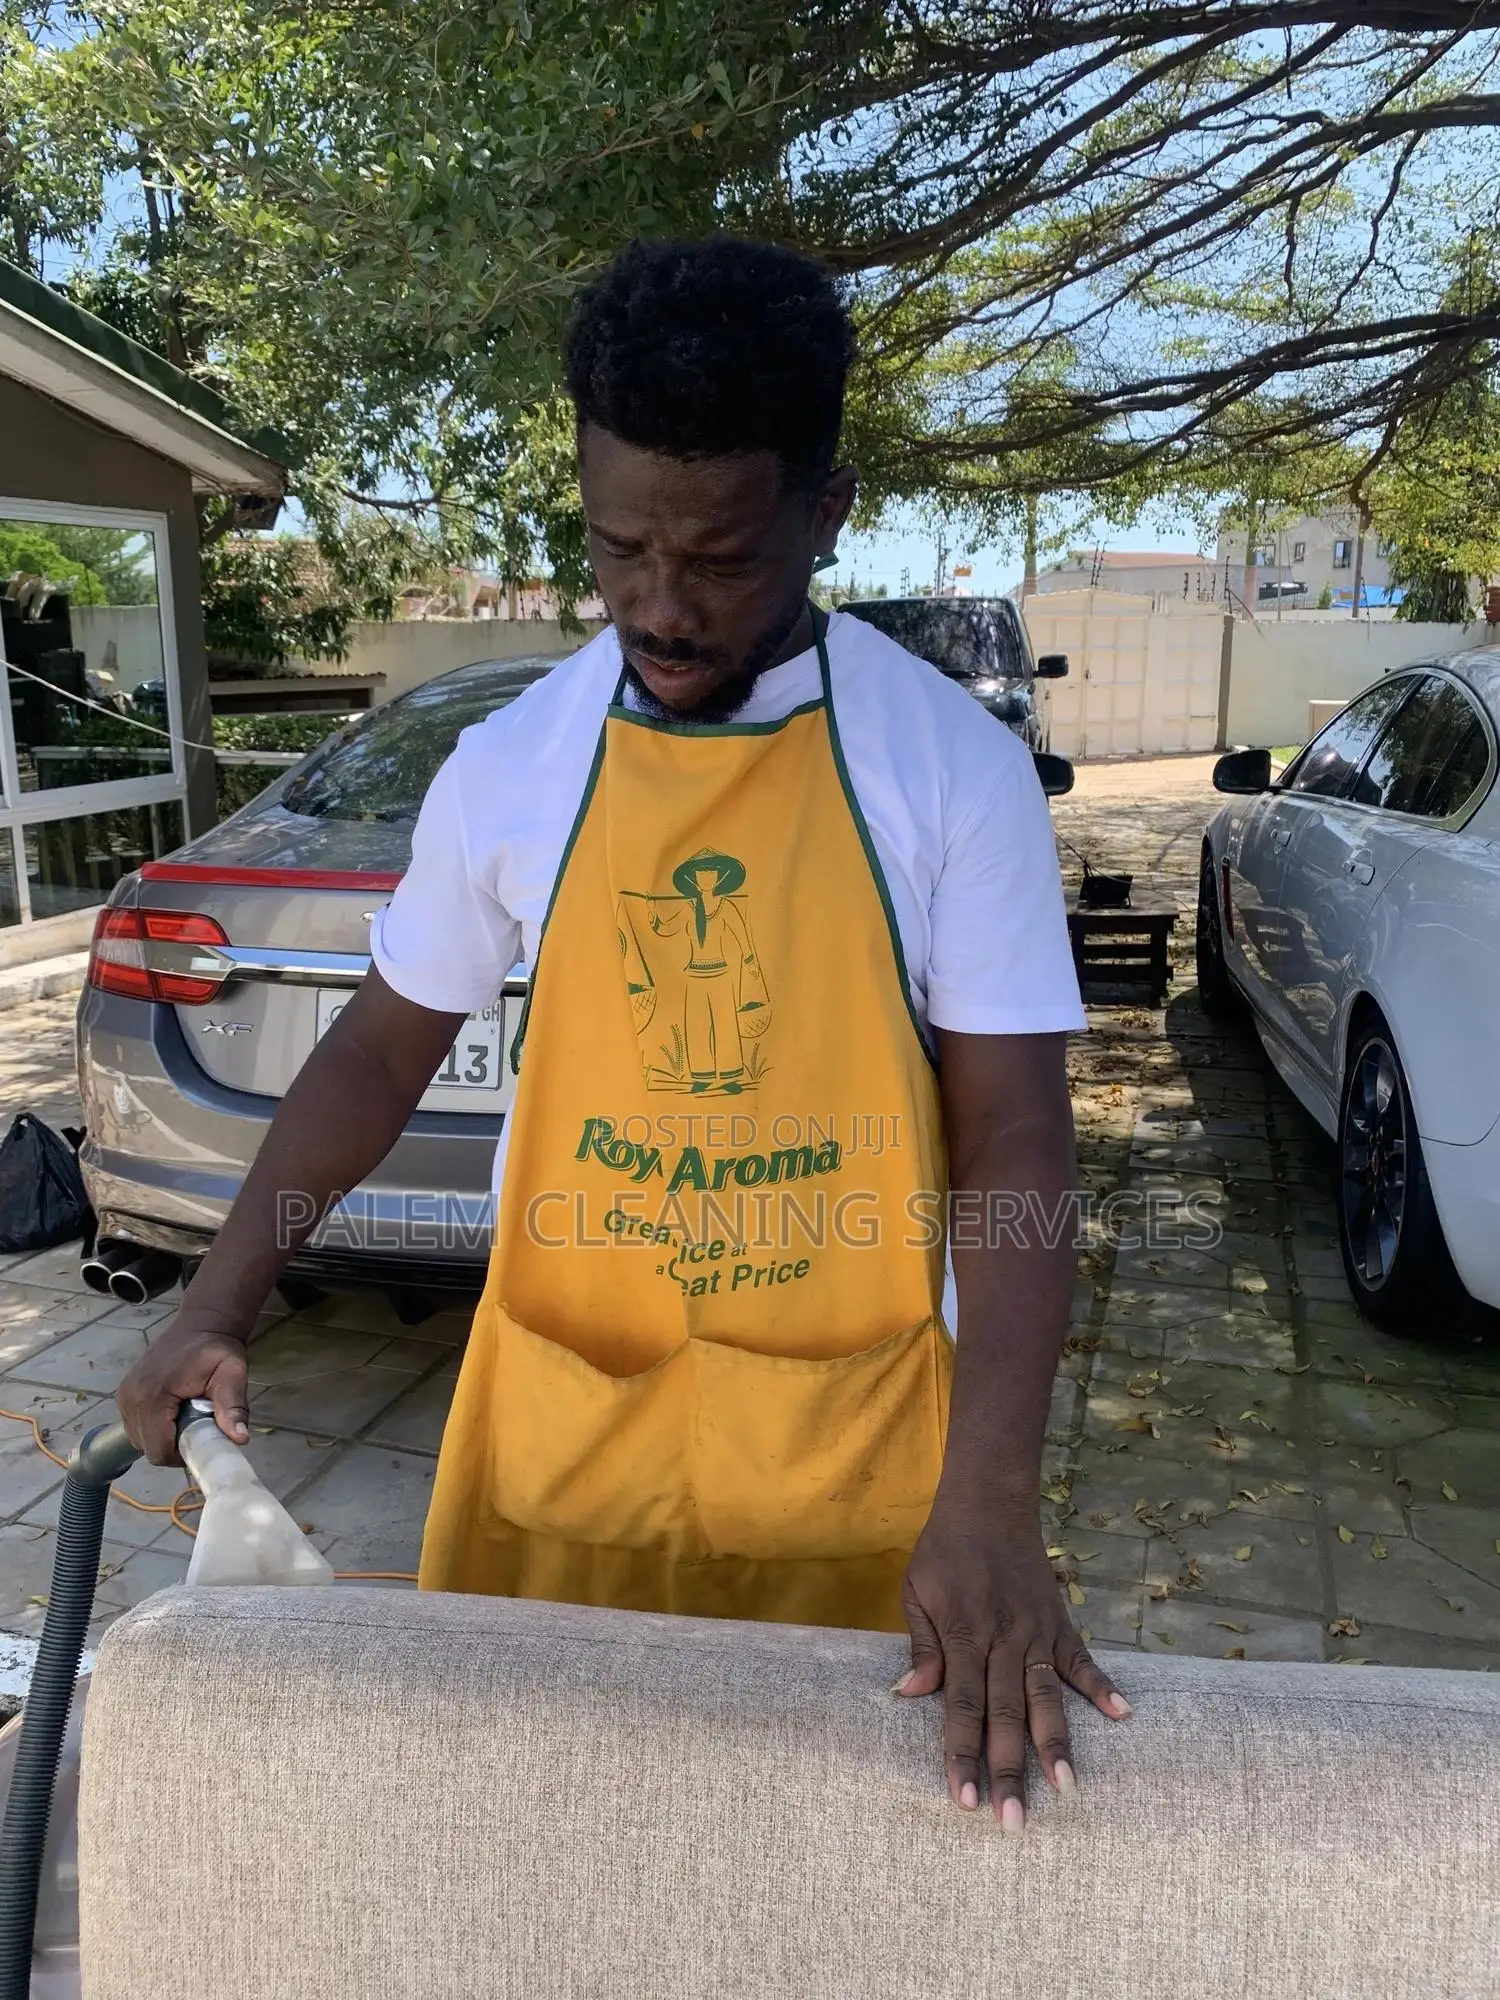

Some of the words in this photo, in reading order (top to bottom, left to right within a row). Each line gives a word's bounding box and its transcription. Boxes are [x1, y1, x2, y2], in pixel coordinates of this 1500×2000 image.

[482, 1003, 500, 1021] GH
[438, 1044, 489, 1083] 13
[574, 1118, 663, 1183] Roy
[666, 1139, 843, 1196] Aroma
[603, 1209, 678, 1249] Grea
[679, 1239, 726, 1264] ice
[730, 1243, 748, 1257] at
[655, 1264, 665, 1275] a
[731, 1258, 811, 1292] Price
